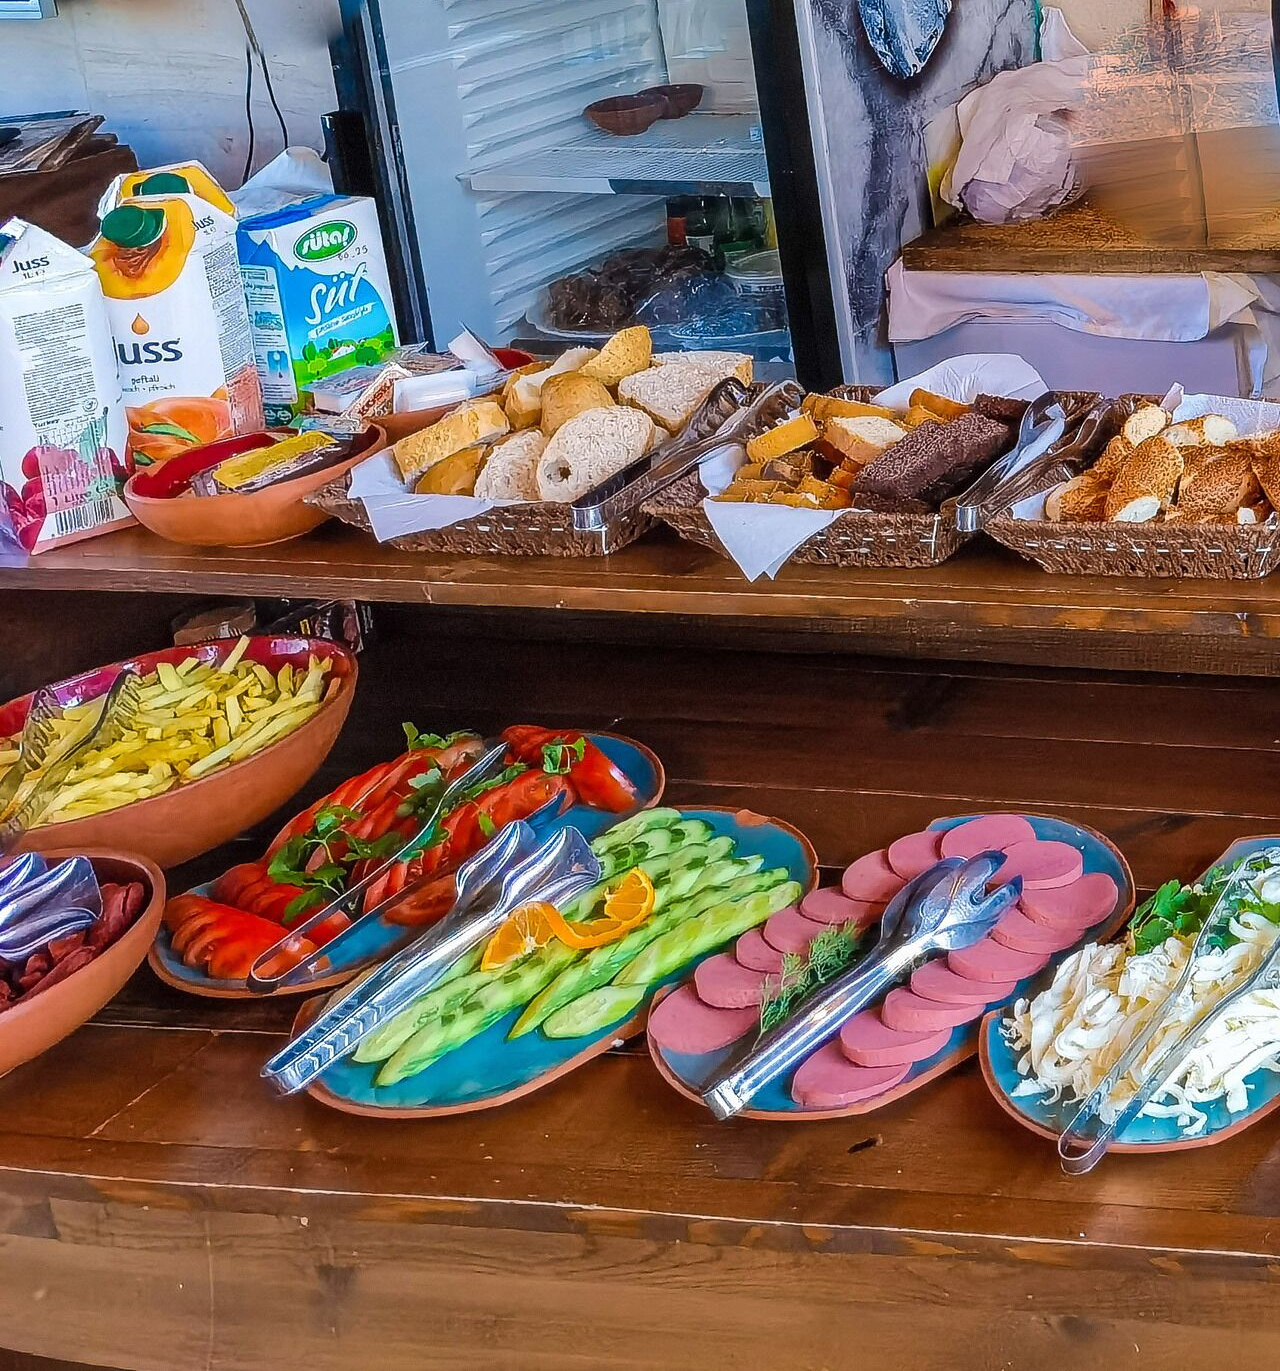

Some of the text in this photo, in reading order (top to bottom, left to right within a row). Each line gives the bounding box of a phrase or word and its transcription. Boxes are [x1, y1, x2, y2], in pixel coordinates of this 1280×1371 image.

[192, 215, 215, 231] Juss
[12, 255, 50, 274] Juss
[305, 262, 367, 325] Süt
[358, 378, 394, 417] KOSK
